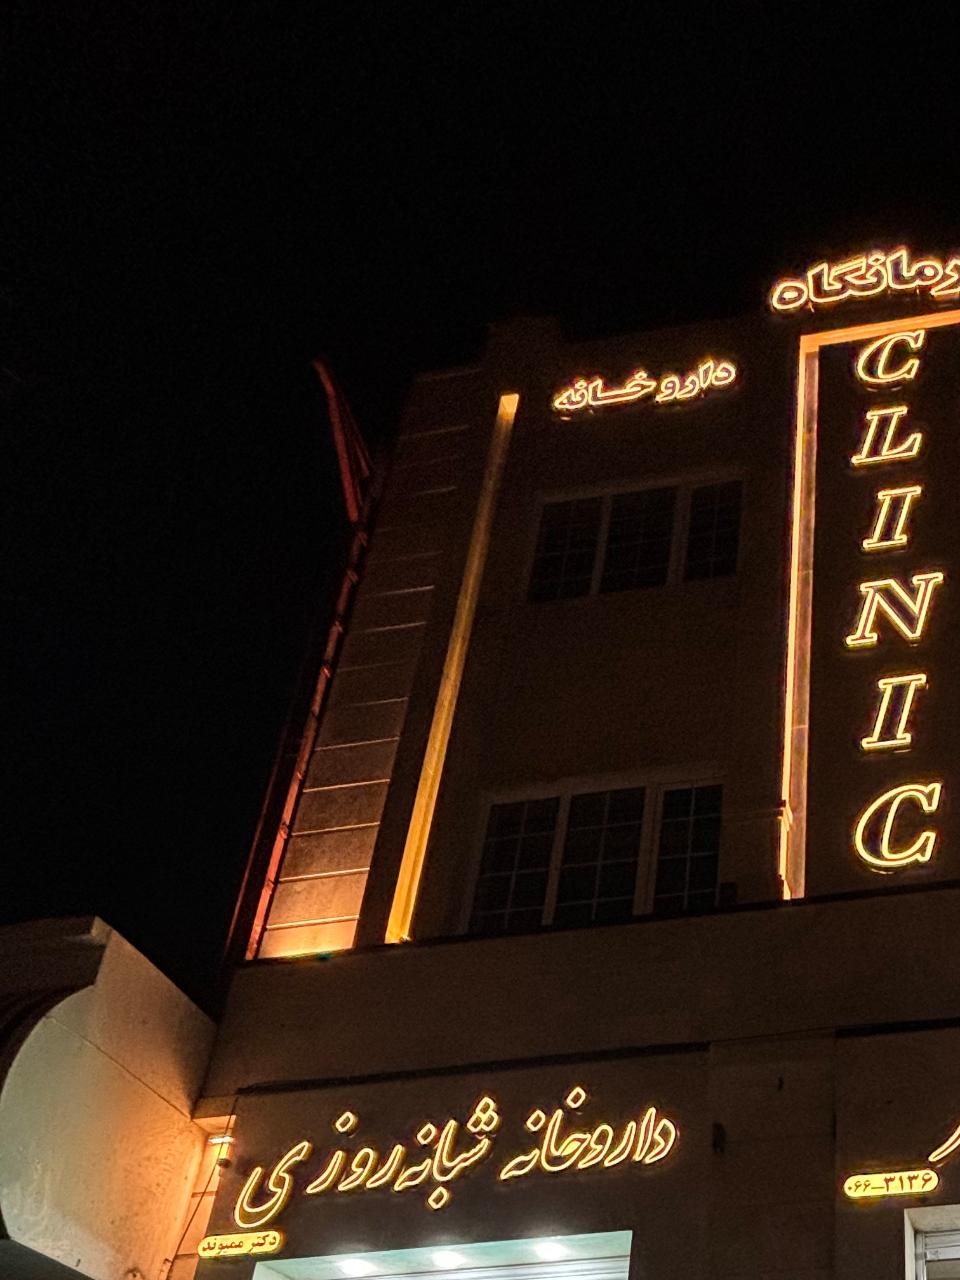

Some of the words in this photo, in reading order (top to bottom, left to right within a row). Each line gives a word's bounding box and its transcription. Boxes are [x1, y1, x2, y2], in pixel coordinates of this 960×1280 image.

[553, 358, 737, 409] داروخانه
[845, 329, 944, 868] CLINIC
[499, 1086, 677, 1180] داروخانه
[249, 1233, 278, 1254] دکتر
